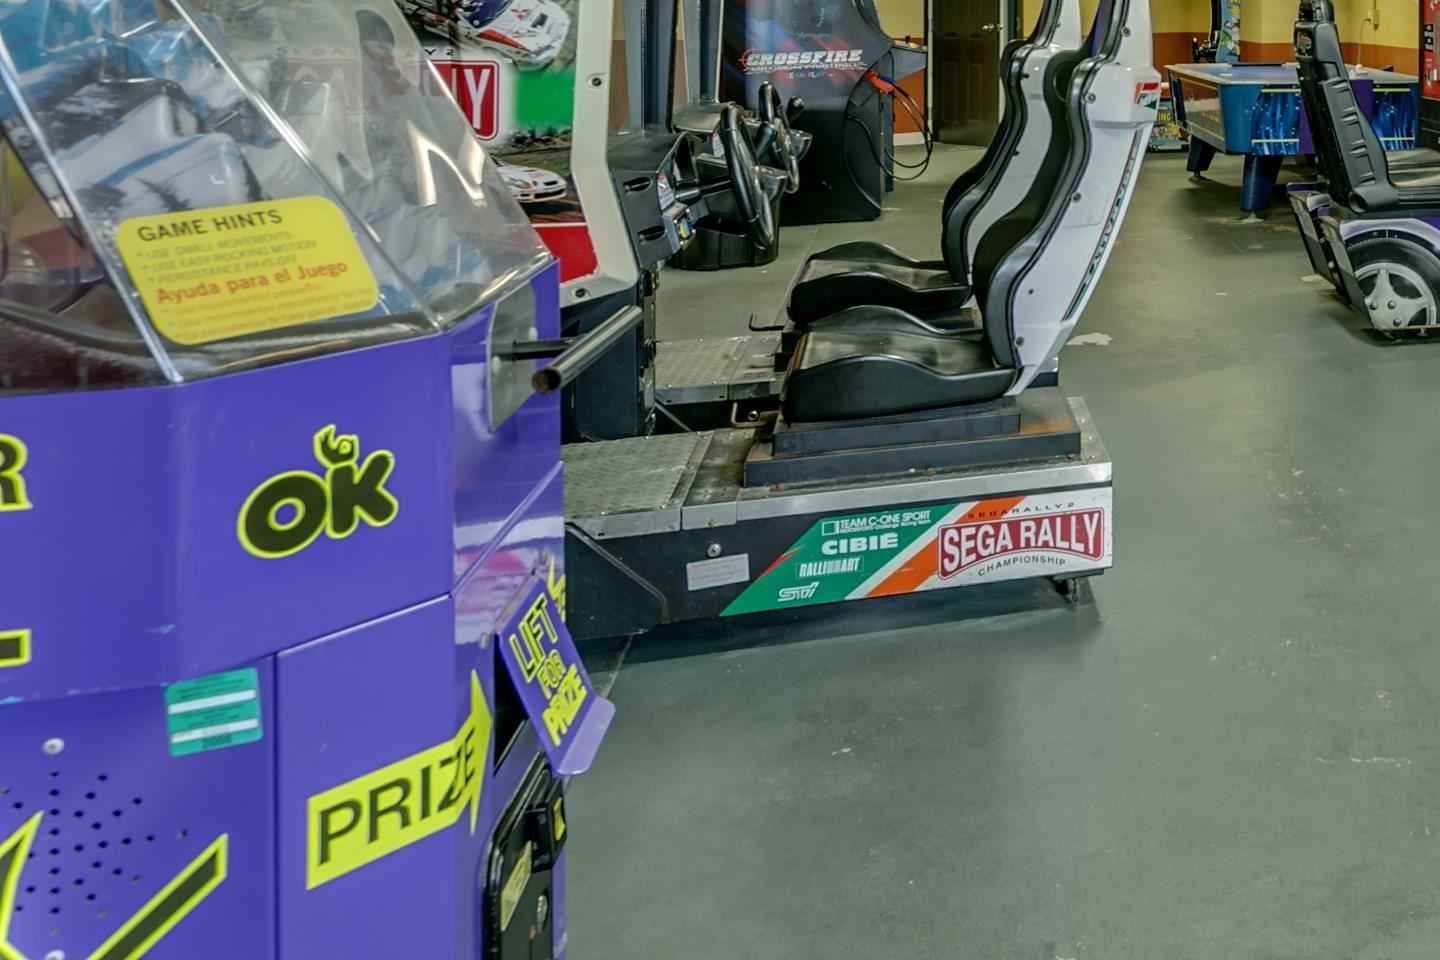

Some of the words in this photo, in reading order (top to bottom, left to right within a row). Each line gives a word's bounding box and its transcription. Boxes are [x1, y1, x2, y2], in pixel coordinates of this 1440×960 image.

[746, 49, 863, 66] CROSSFIRE
[137, 219, 208, 242] GAME
[214, 210, 283, 232] HINTS
[157, 282, 220, 305] Ayuda
[226, 275, 269, 294] para
[276, 266, 292, 283] el
[297, 261, 348, 280] Juego
[237, 432, 399, 559] OK
[840, 518, 866, 529] TEAM
[868, 514, 900, 525] C-ONE
[902, 510, 931, 521] SPORT
[942, 523, 1013, 572] SEGA
[1020, 513, 1099, 554] RALLY
[978, 555, 1067, 577] CHAMPIONSHIP
[509, 592, 558, 683] LIFT
[536, 649, 567, 700] FOR
[542, 663, 588, 747] PRIZE
[317, 726, 476, 867] PRIZE
